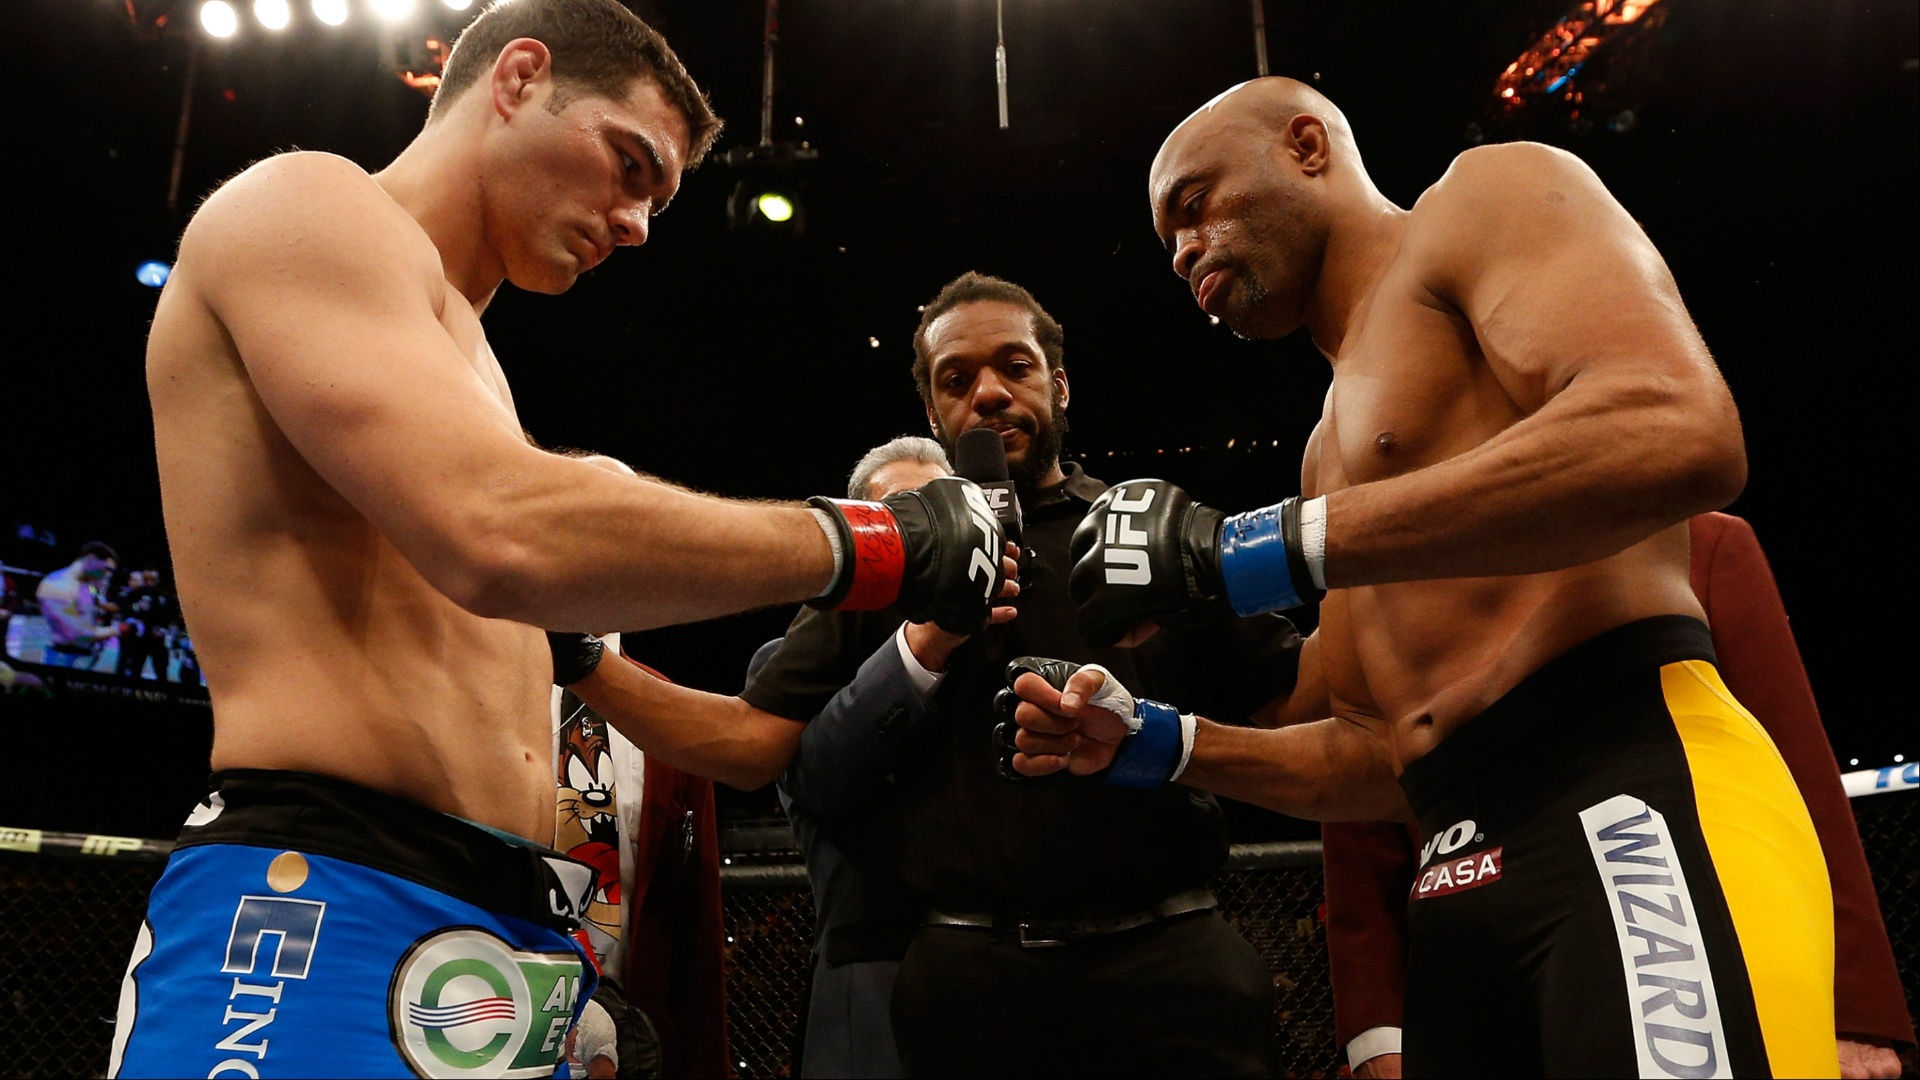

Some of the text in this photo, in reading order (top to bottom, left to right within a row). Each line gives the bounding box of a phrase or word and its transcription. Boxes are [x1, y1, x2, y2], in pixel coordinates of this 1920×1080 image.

[1104, 487, 1157, 586] UFC
[1418, 853, 1498, 894] CASA
[1594, 804, 1720, 1079] WIZARD
